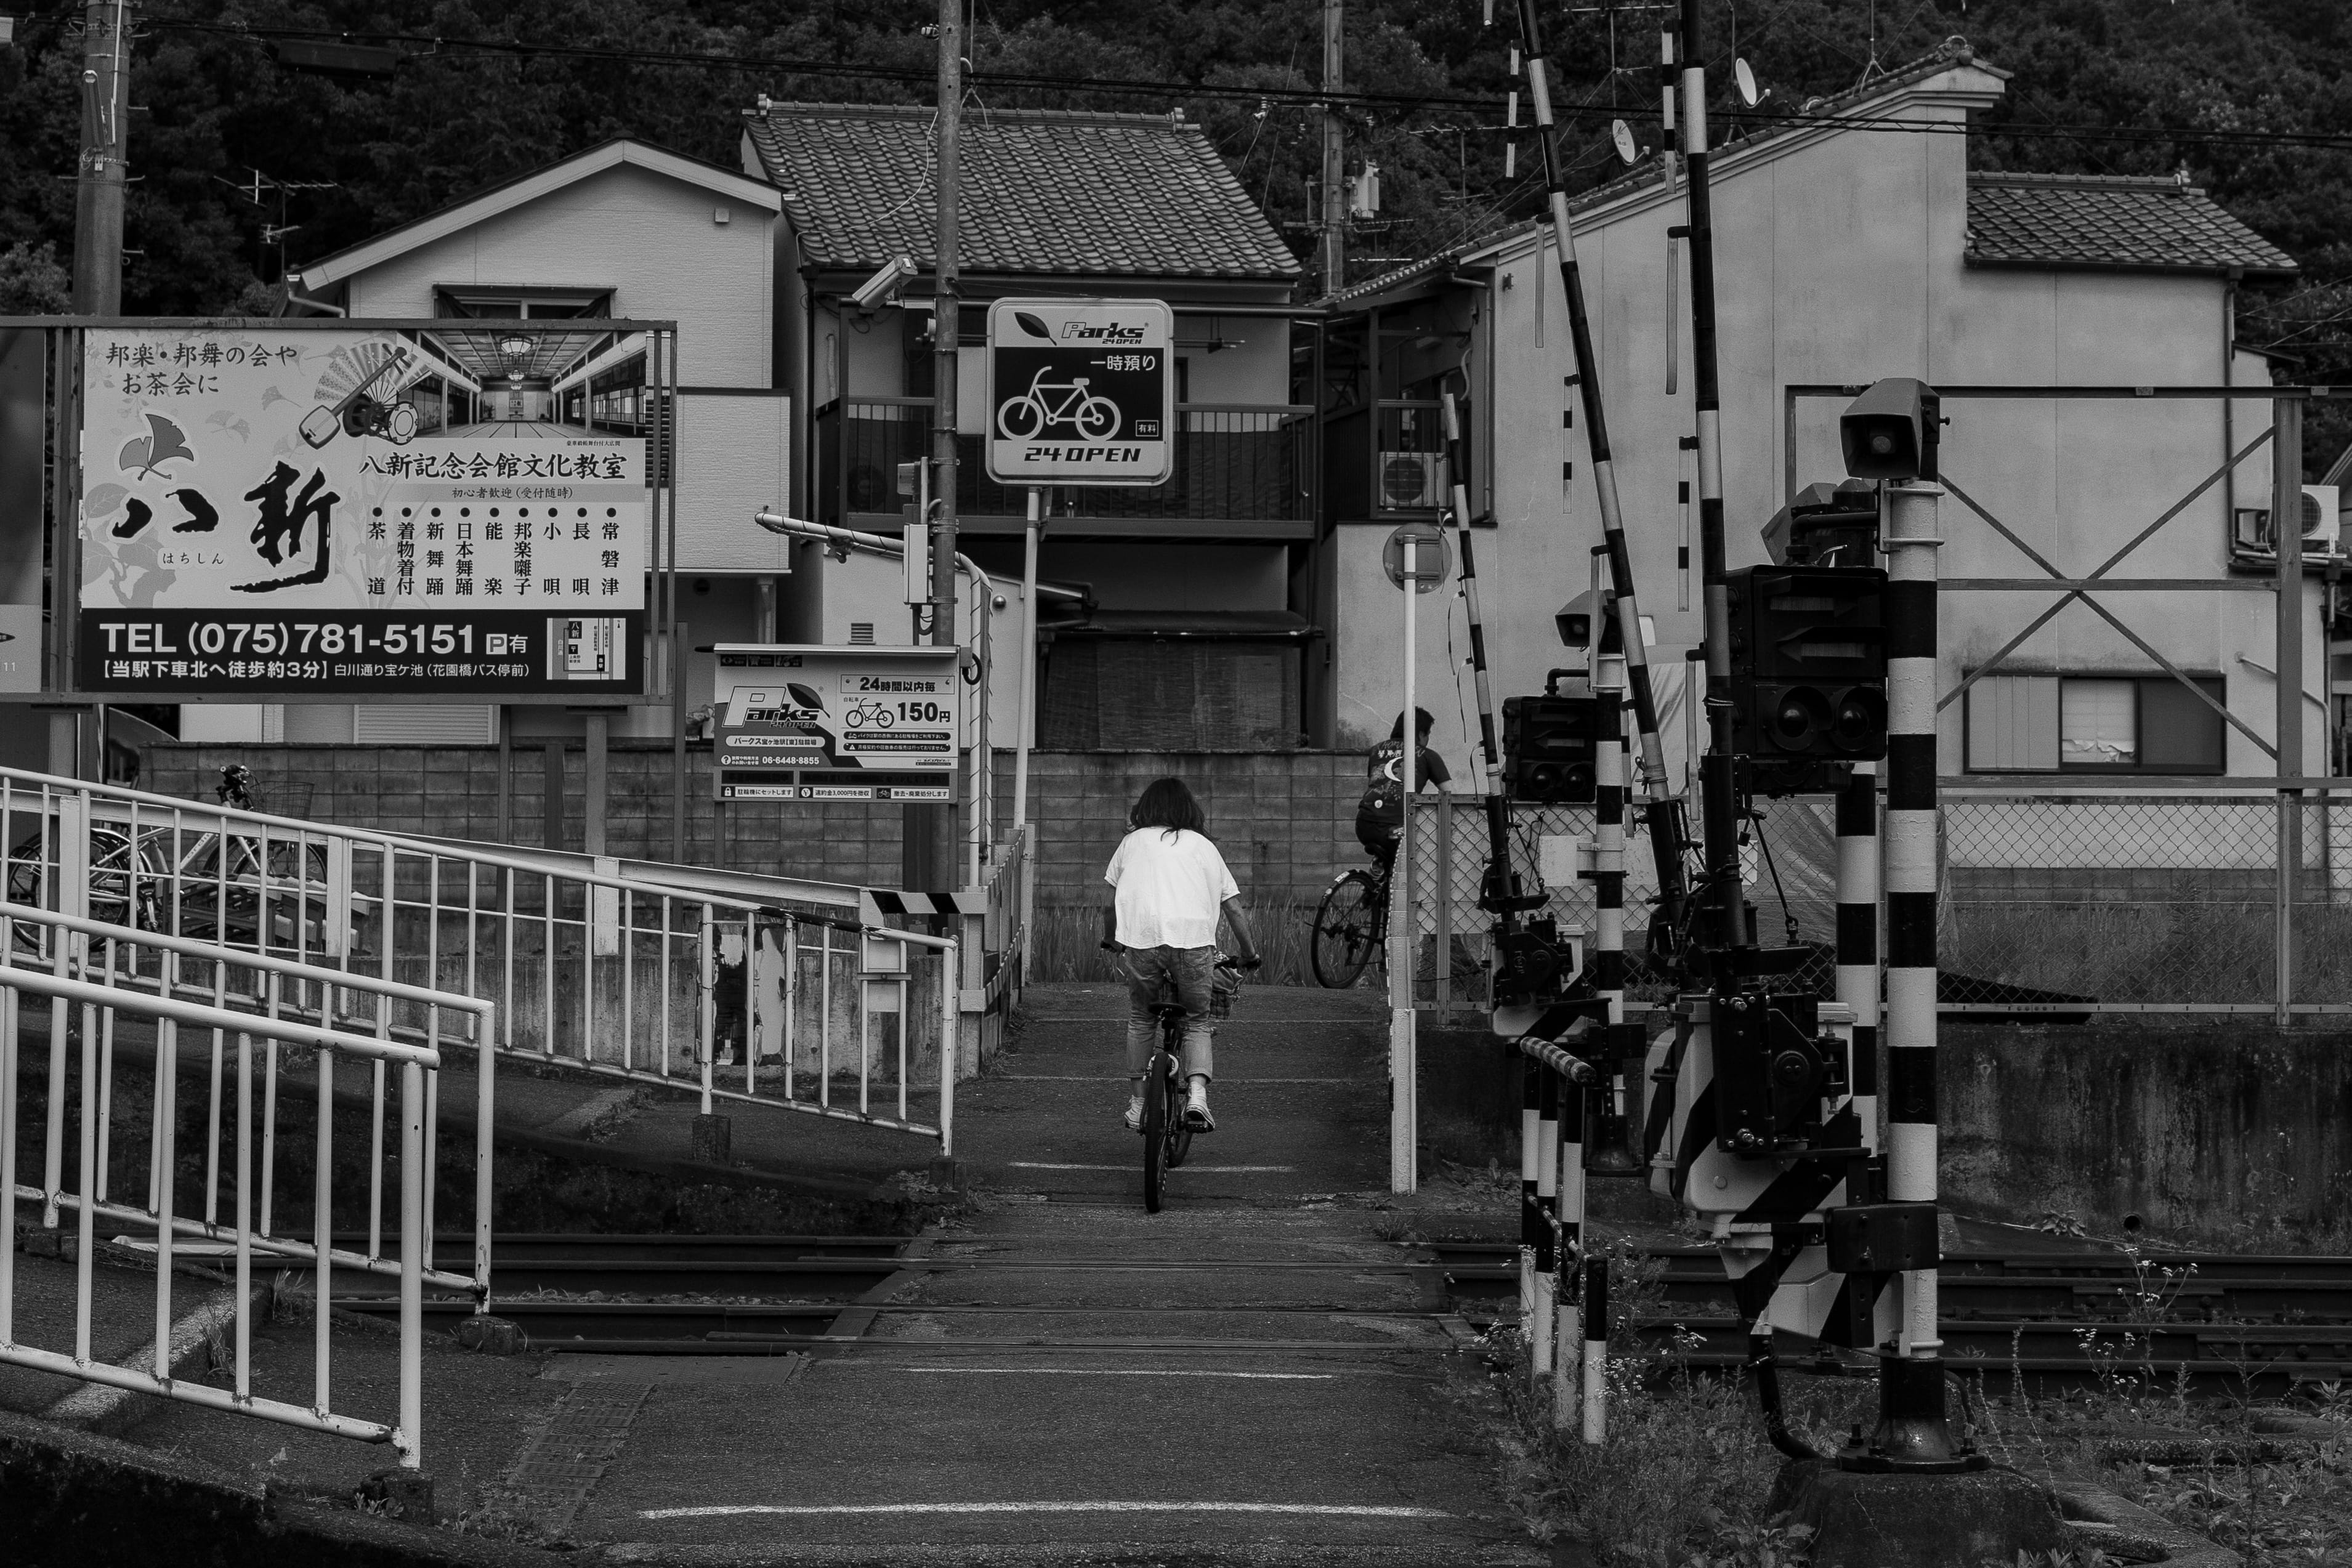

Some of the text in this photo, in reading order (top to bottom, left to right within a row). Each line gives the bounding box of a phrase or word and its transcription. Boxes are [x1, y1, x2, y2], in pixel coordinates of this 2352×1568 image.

[1061, 322, 1145, 338] Parks
[105, 342, 297, 369] 邦楽・邦舞の会や
[1091, 355, 1156, 371] 一時預り
[122, 371, 219, 397] お茶会に
[1138, 424, 1156, 433] 有料
[358, 451, 628, 480] 八新記念会館文化教室
[111, 460, 341, 594] 八新
[162, 552, 224, 565] はちしん
[367, 522, 386, 596] 茶道
[396, 522, 415, 596] 着物着付
[426, 522, 444, 596] 新舞踊
[455, 522, 474, 596] 日本舞踊
[484, 522, 503, 596] 能楽
[543, 522, 562, 596] 小唄
[572, 522, 591, 596] 長唄
[600, 522, 620, 596] 常磐津
[99, 621, 472, 656] TEL (075)781-5151
[859, 676, 936, 693] 24時間以内毎
[722, 685, 820, 728] Parks
[897, 701, 951, 723] 150円
[762, 756, 820, 765] 06-6448-8855
